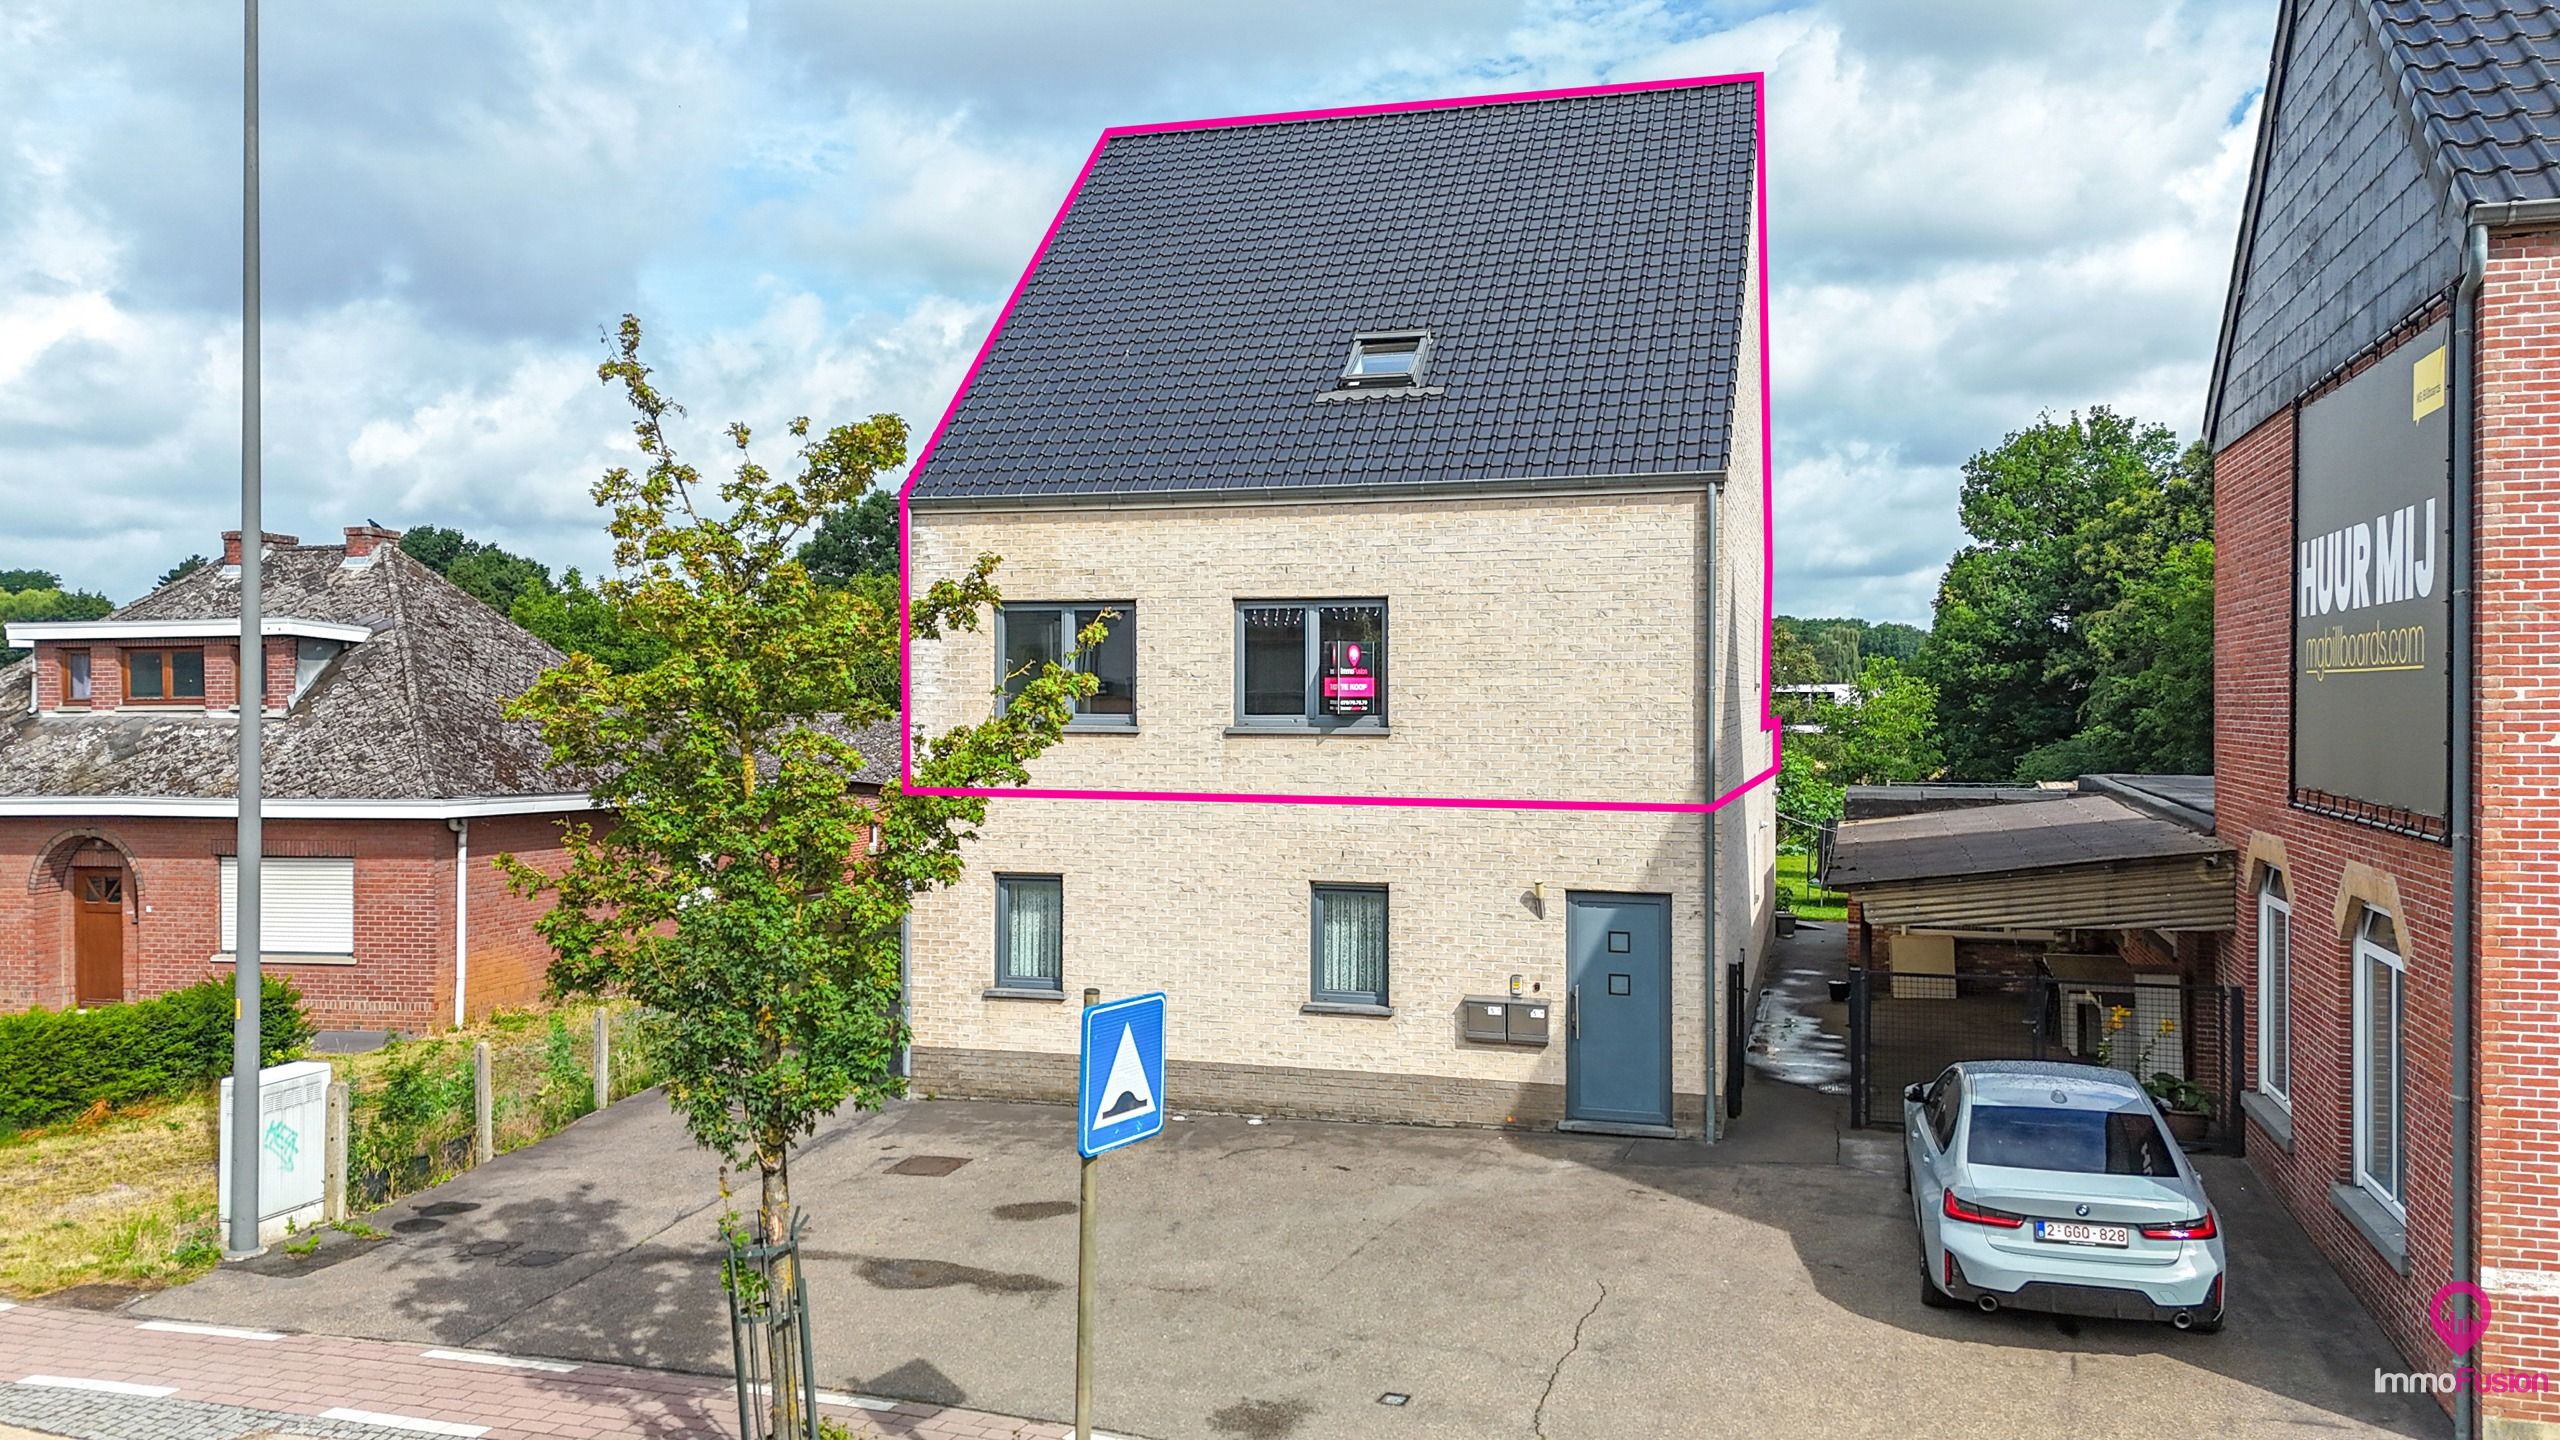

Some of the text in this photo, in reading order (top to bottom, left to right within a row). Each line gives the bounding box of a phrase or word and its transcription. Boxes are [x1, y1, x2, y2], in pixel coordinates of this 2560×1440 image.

[2301, 497, 2436, 618] HUUR MIJ
[2305, 620, 2425, 682] mgbillboards.com
